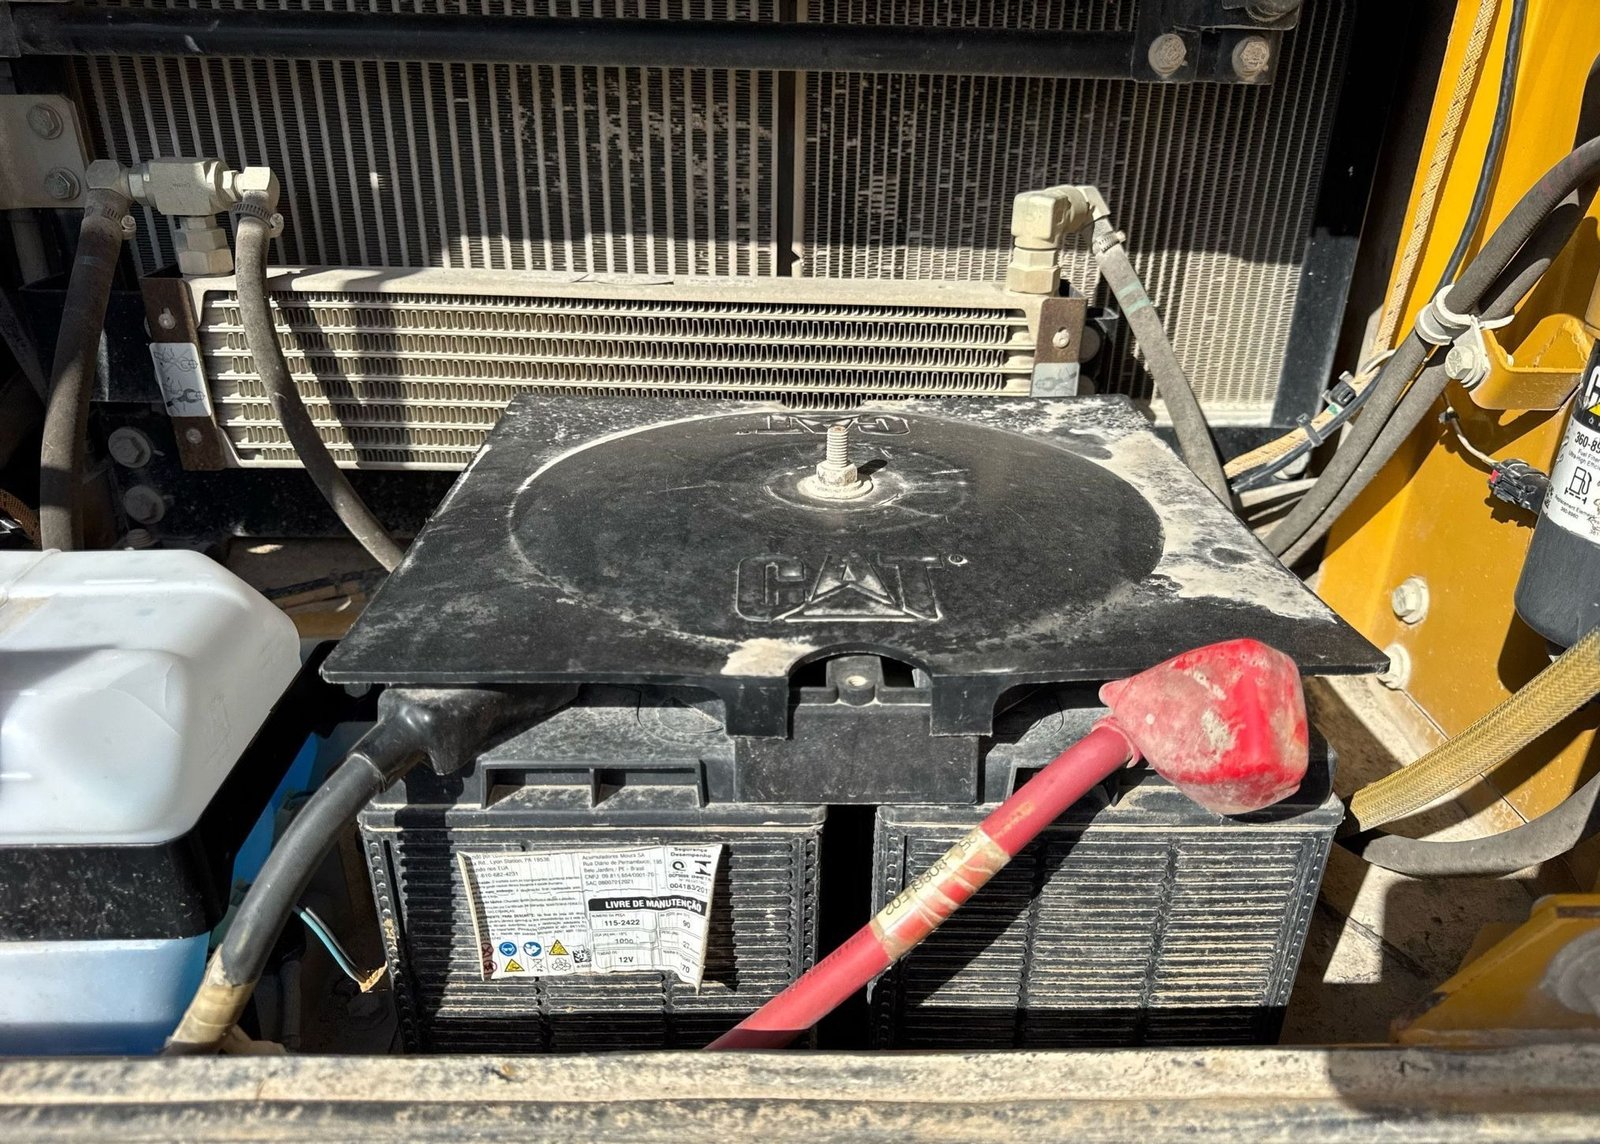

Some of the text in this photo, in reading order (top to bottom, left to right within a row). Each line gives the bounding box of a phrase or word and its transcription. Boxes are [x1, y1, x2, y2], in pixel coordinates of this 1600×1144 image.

[1578, 448, 1588, 457] Fuel
[735, 553, 944, 624] CAT
[605, 900, 631, 909] LIVRE
[646, 898, 702, 912] MANUTENÇÃO
[682, 920, 691, 929] 90
[682, 963, 690, 973] 70
